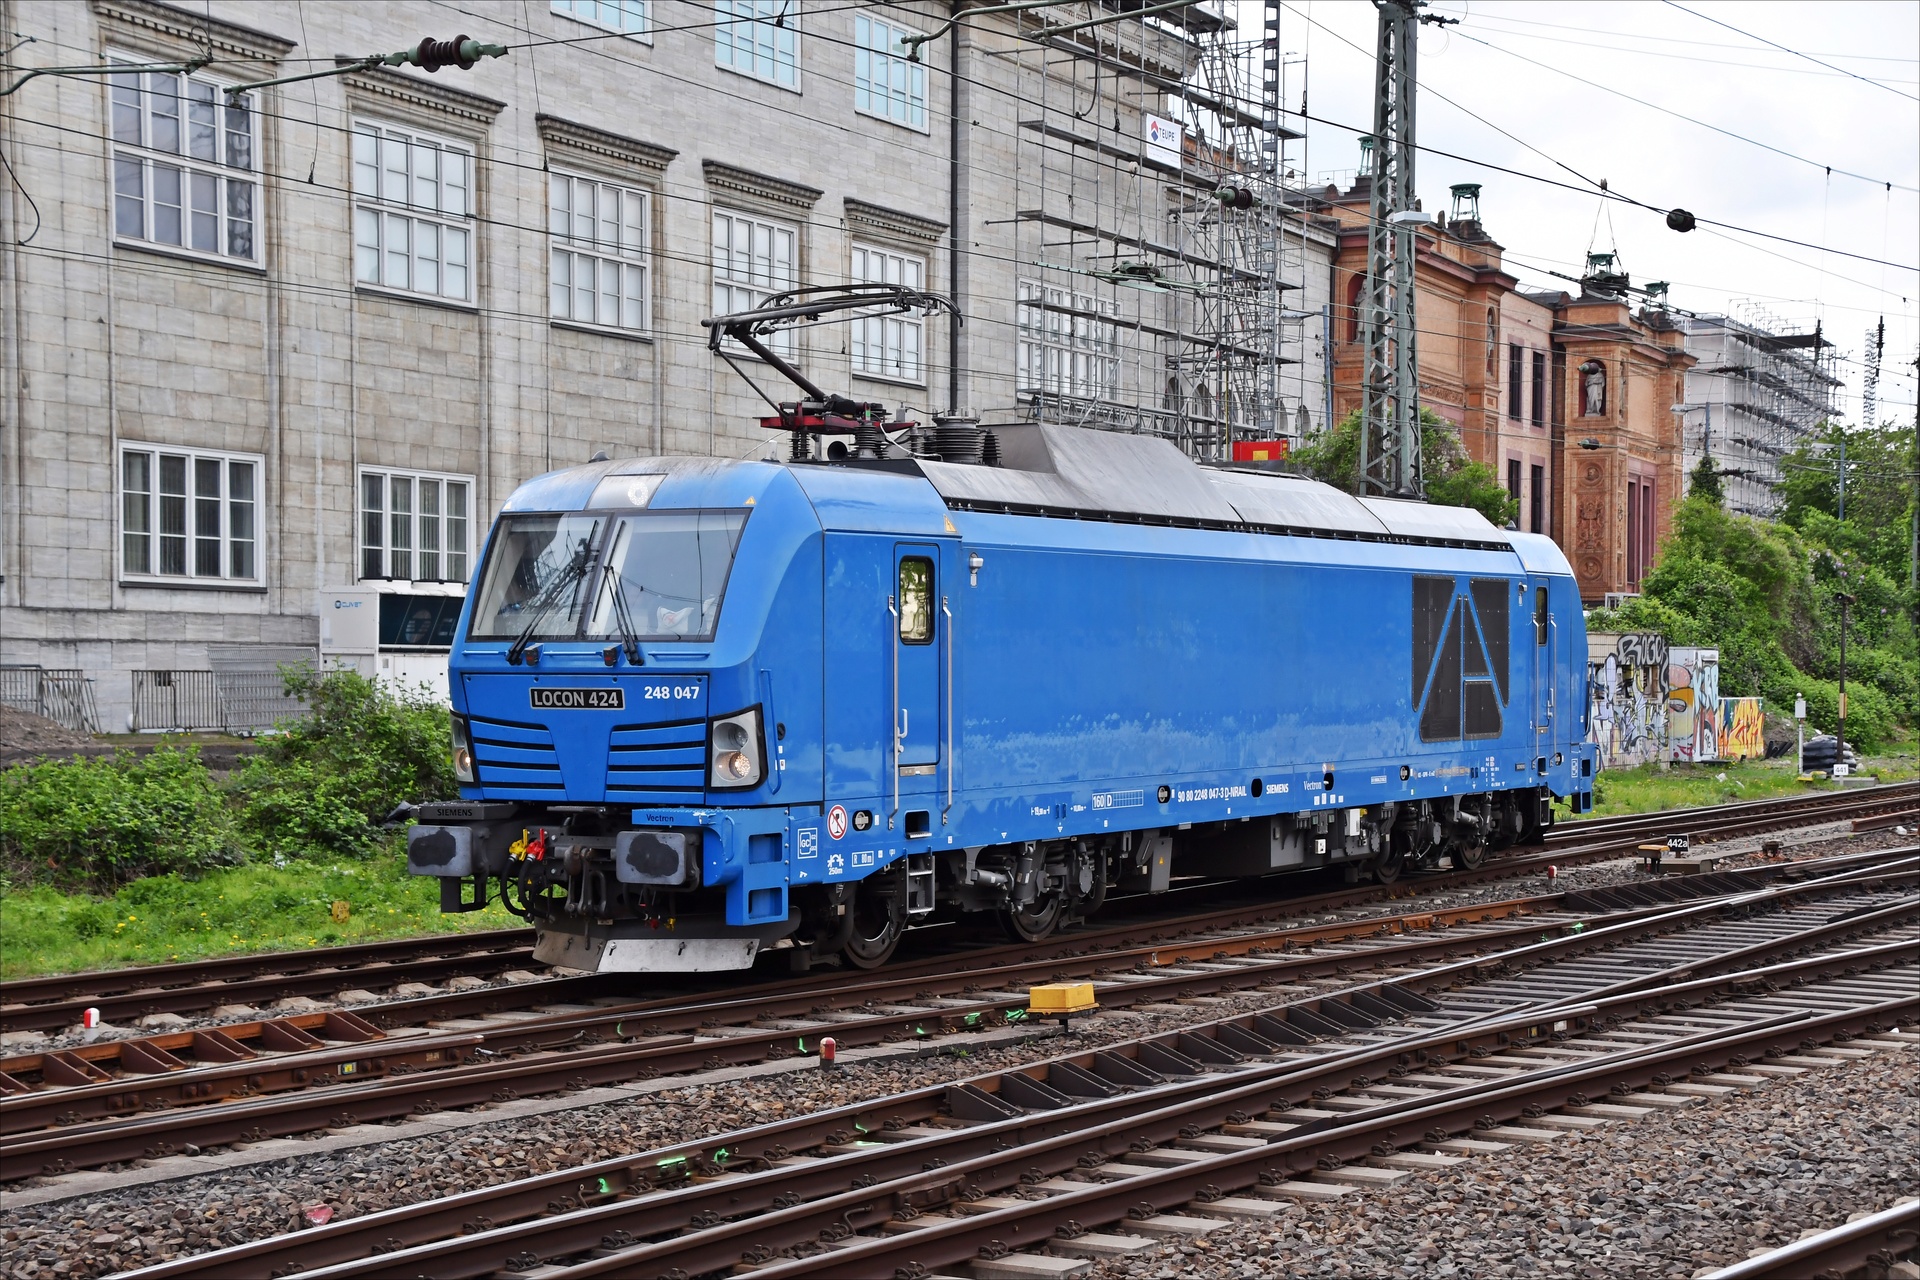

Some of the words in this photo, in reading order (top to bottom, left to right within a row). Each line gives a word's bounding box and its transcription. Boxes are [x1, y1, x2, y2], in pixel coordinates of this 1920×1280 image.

[1159, 128, 1175, 142] TEUPE
[534, 690, 585, 707] LOCON
[588, 691, 619, 707] 424
[644, 685, 671, 700] 248
[673, 686, 700, 700] 047
[1266, 783, 1289, 795] SIEMENS
[1303, 780, 1322, 791] Vectron
[1177, 790, 1185, 802] 90
[1186, 789, 1193, 802] 80
[1194, 788, 1208, 801] 2248
[1208, 786, 1224, 800] 047-3
[1225, 785, 1247, 800] D-NRAIL
[1092, 795, 1105, 808] 160
[1106, 794, 1112, 807] D
[437, 808, 473, 817] SIEMENS
[646, 813, 674, 823] Vectron
[1667, 838, 1688, 848] 442a
